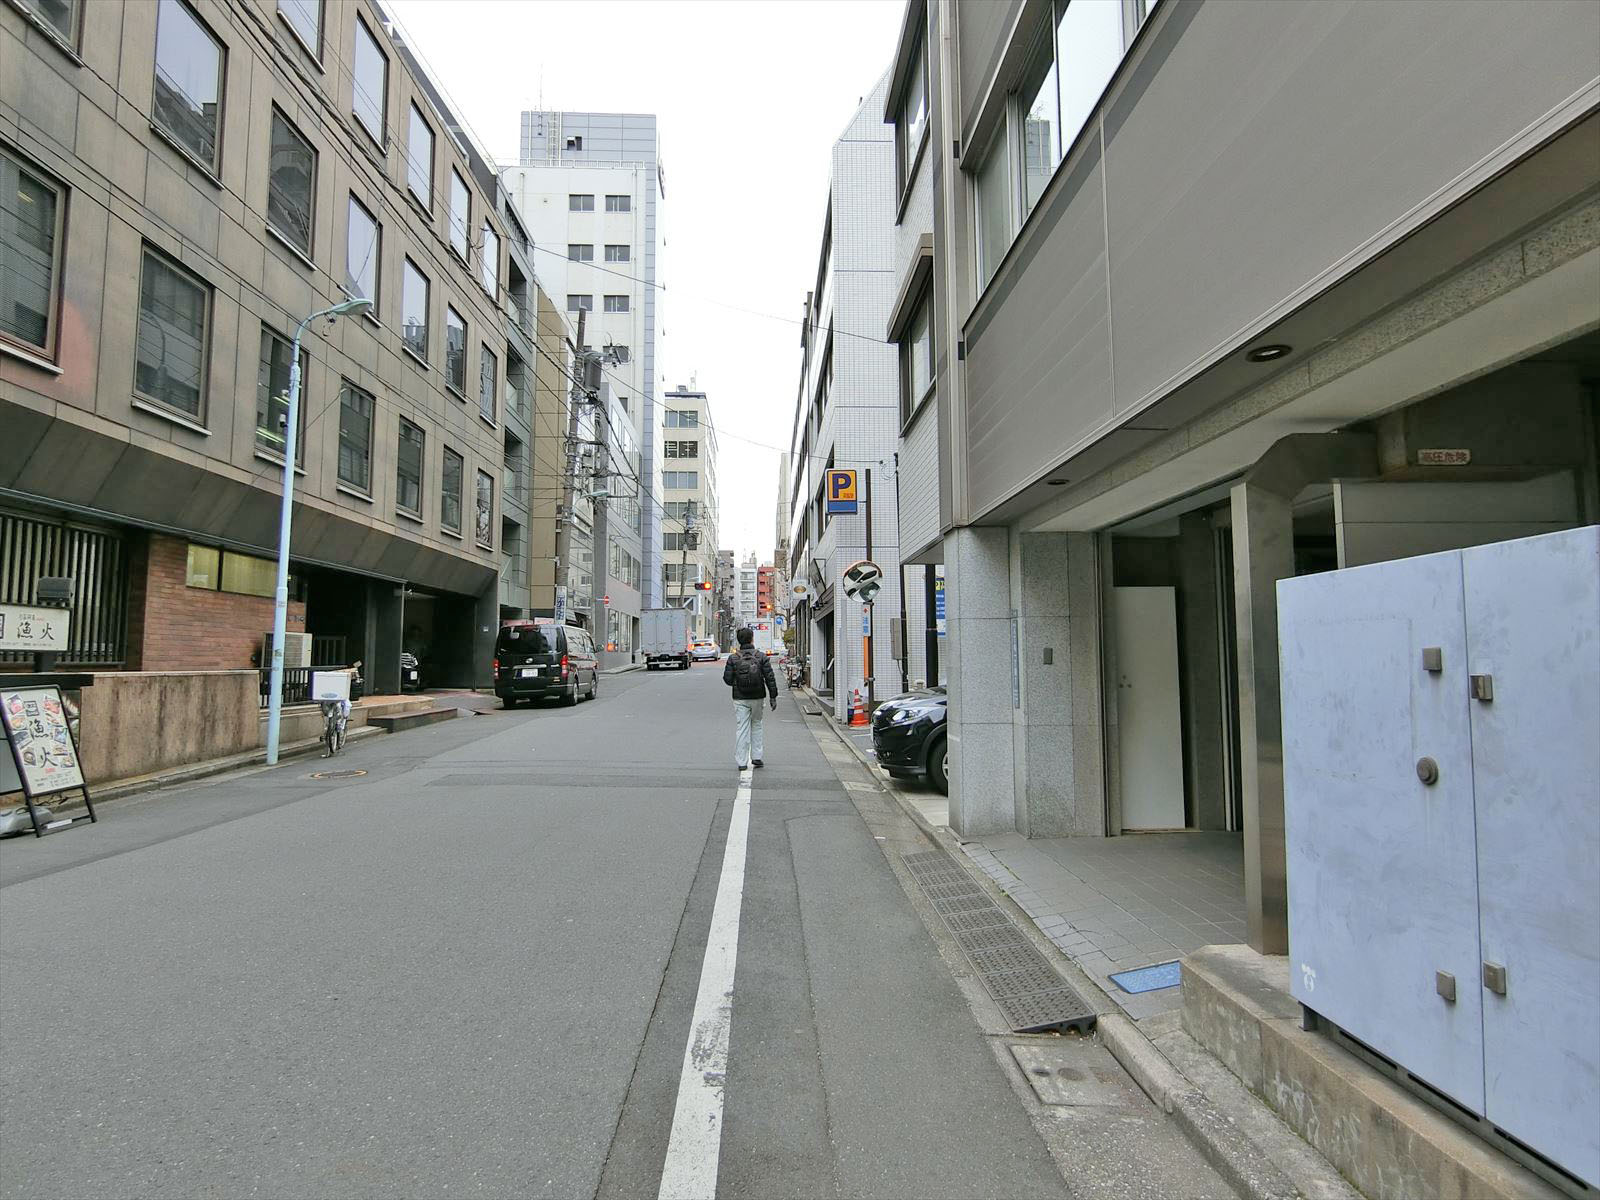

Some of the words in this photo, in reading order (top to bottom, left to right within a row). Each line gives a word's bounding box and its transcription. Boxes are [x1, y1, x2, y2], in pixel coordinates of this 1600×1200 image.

[1423, 451, 1468, 463] 高圧危険
[832, 473, 852, 499] P
[17, 621, 55, 641] 漁火
[747, 623, 769, 631] FedEx
[28, 718, 59, 768] 漁火
